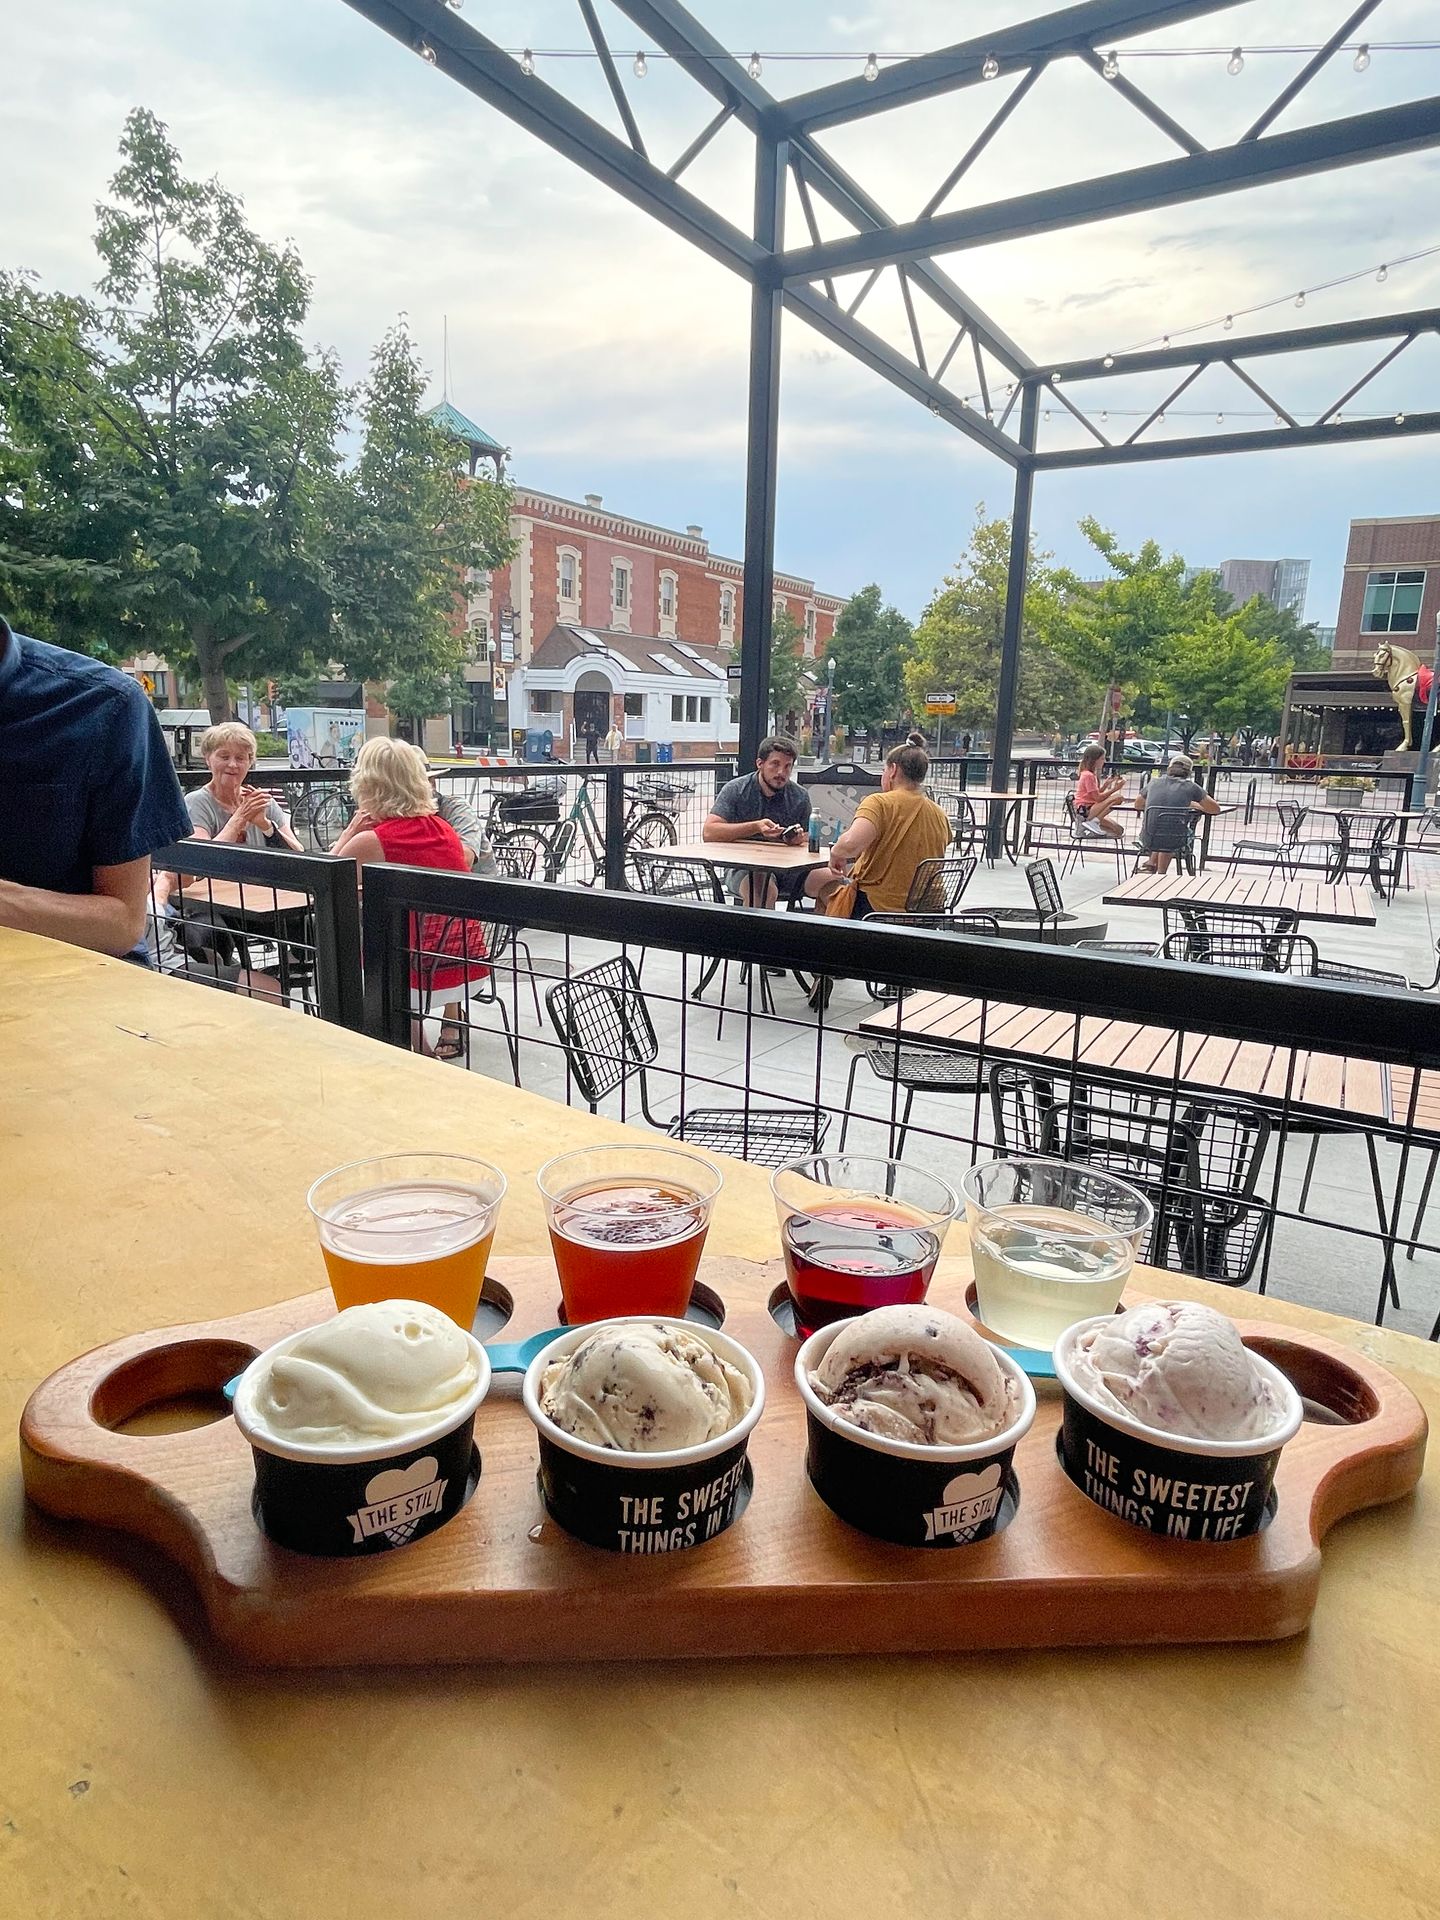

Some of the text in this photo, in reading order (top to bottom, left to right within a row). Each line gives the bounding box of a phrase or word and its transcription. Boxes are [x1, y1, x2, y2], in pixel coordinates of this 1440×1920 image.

[1086, 1438, 1254, 1512] THE SWEETEST
[366, 1490, 432, 1529] THE STIL
[619, 1497, 664, 1525] THE
[940, 1496, 993, 1528] THE STIL
[1084, 1469, 1154, 1531] THINGS
[1167, 1513, 1190, 1540] IN
[617, 1522, 697, 1554] THINGS
[706, 1505, 723, 1540] IN
